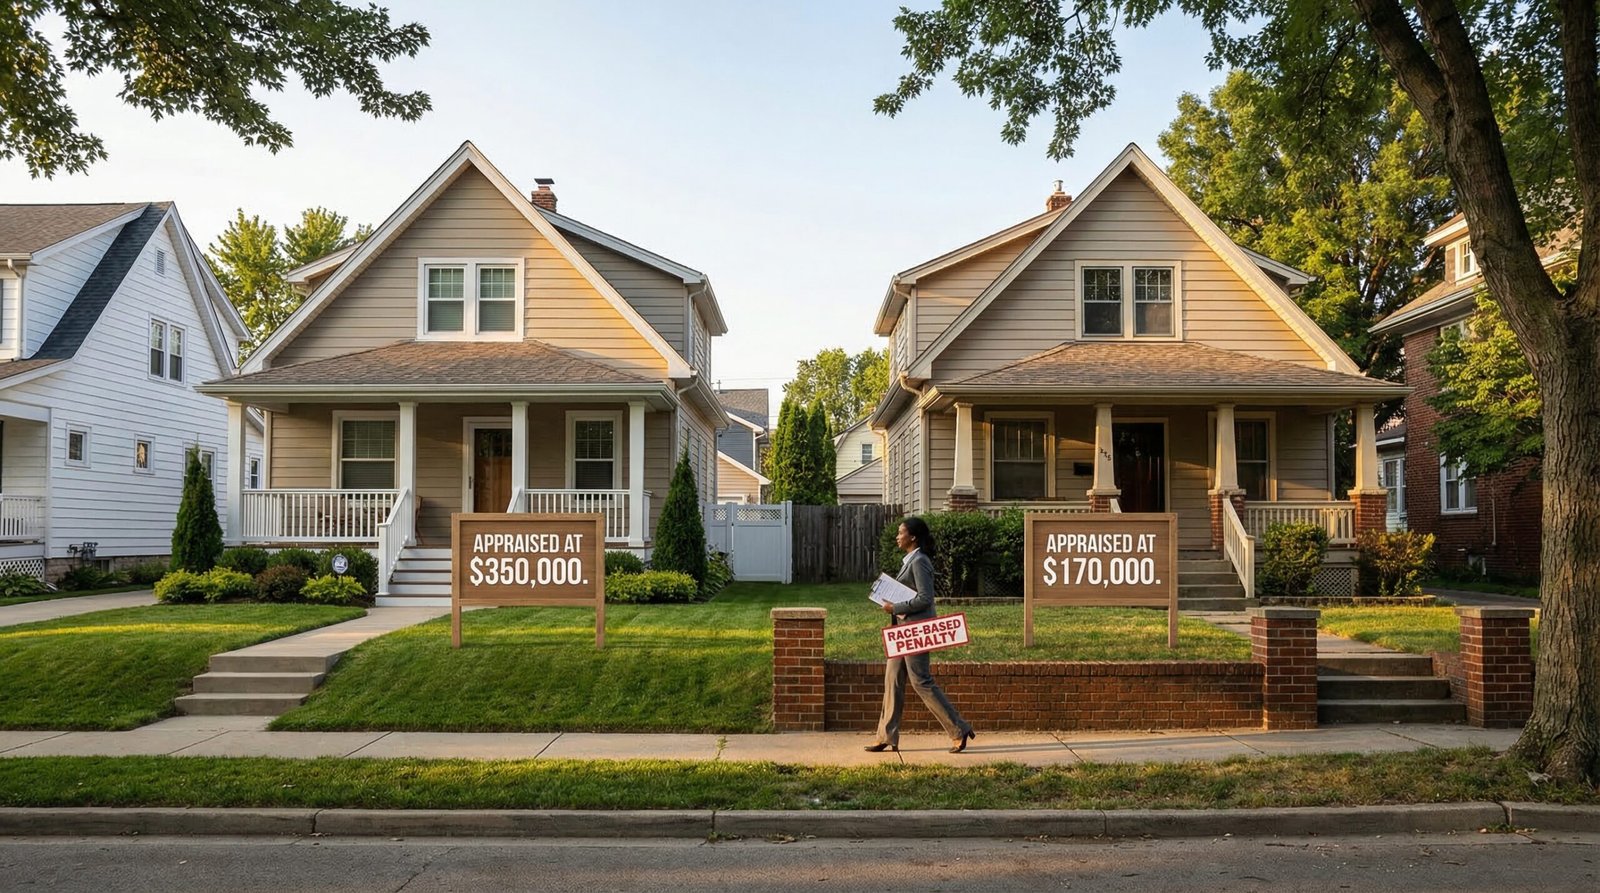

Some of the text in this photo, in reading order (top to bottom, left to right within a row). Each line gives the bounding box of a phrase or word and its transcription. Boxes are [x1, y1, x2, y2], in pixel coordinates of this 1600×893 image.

[473, 533, 583, 553] APPRAISED AT
[1046, 533, 1156, 553] APPRAISED AT
[470, 556, 588, 588] $350,000.
[1043, 556, 1161, 588] $170,000.
[887, 619, 961, 642] RACE-BASED
[895, 630, 957, 653] PENALTY
